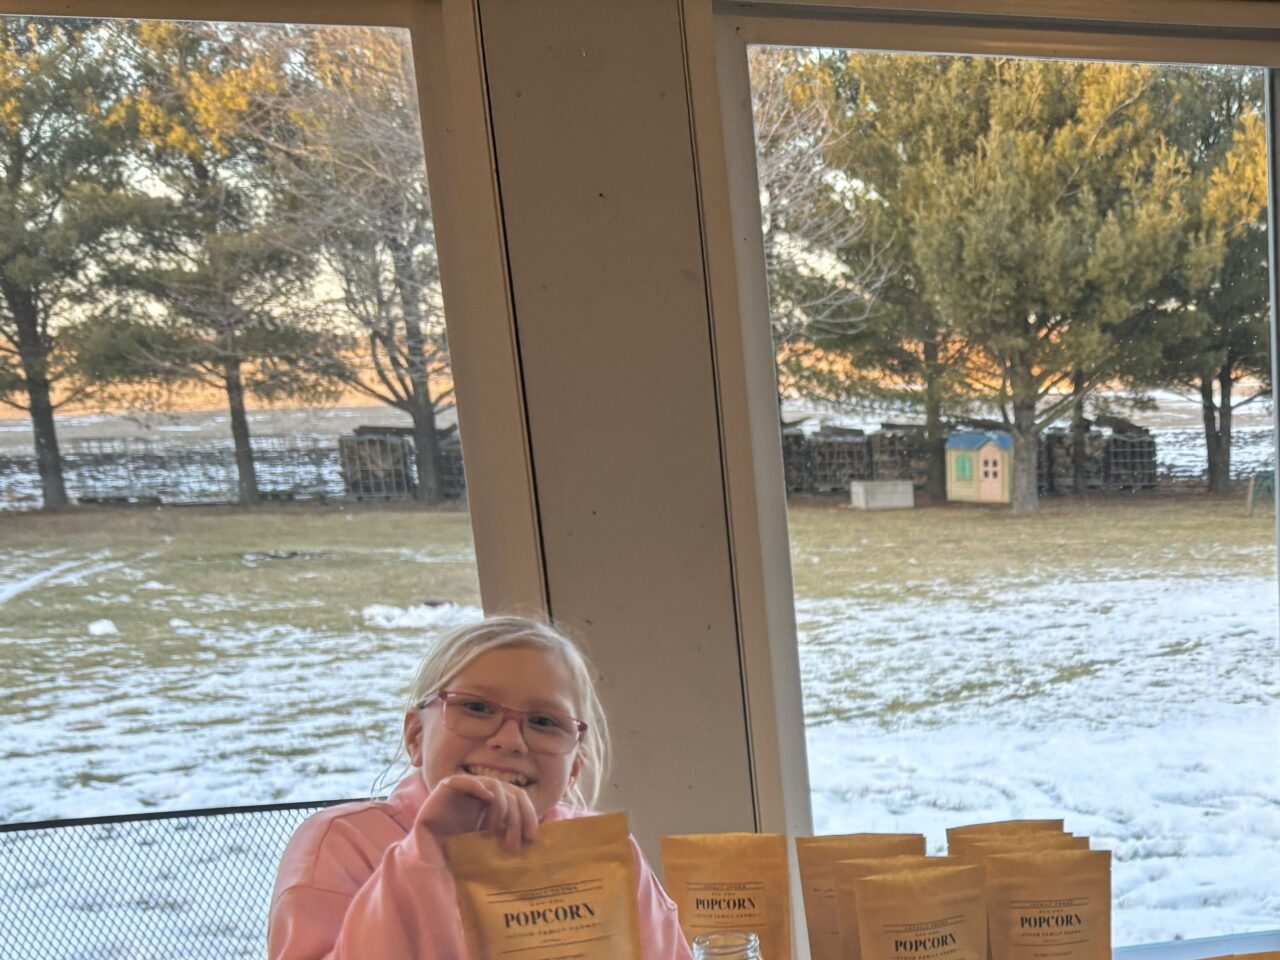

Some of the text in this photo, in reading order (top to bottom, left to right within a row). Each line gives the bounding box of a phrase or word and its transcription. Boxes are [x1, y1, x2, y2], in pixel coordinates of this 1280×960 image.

[695, 897, 756, 910] POPCORN
[503, 902, 596, 929] POPCORN
[1020, 913, 1082, 929] POPCORN
[894, 932, 956, 953] POPCORN
